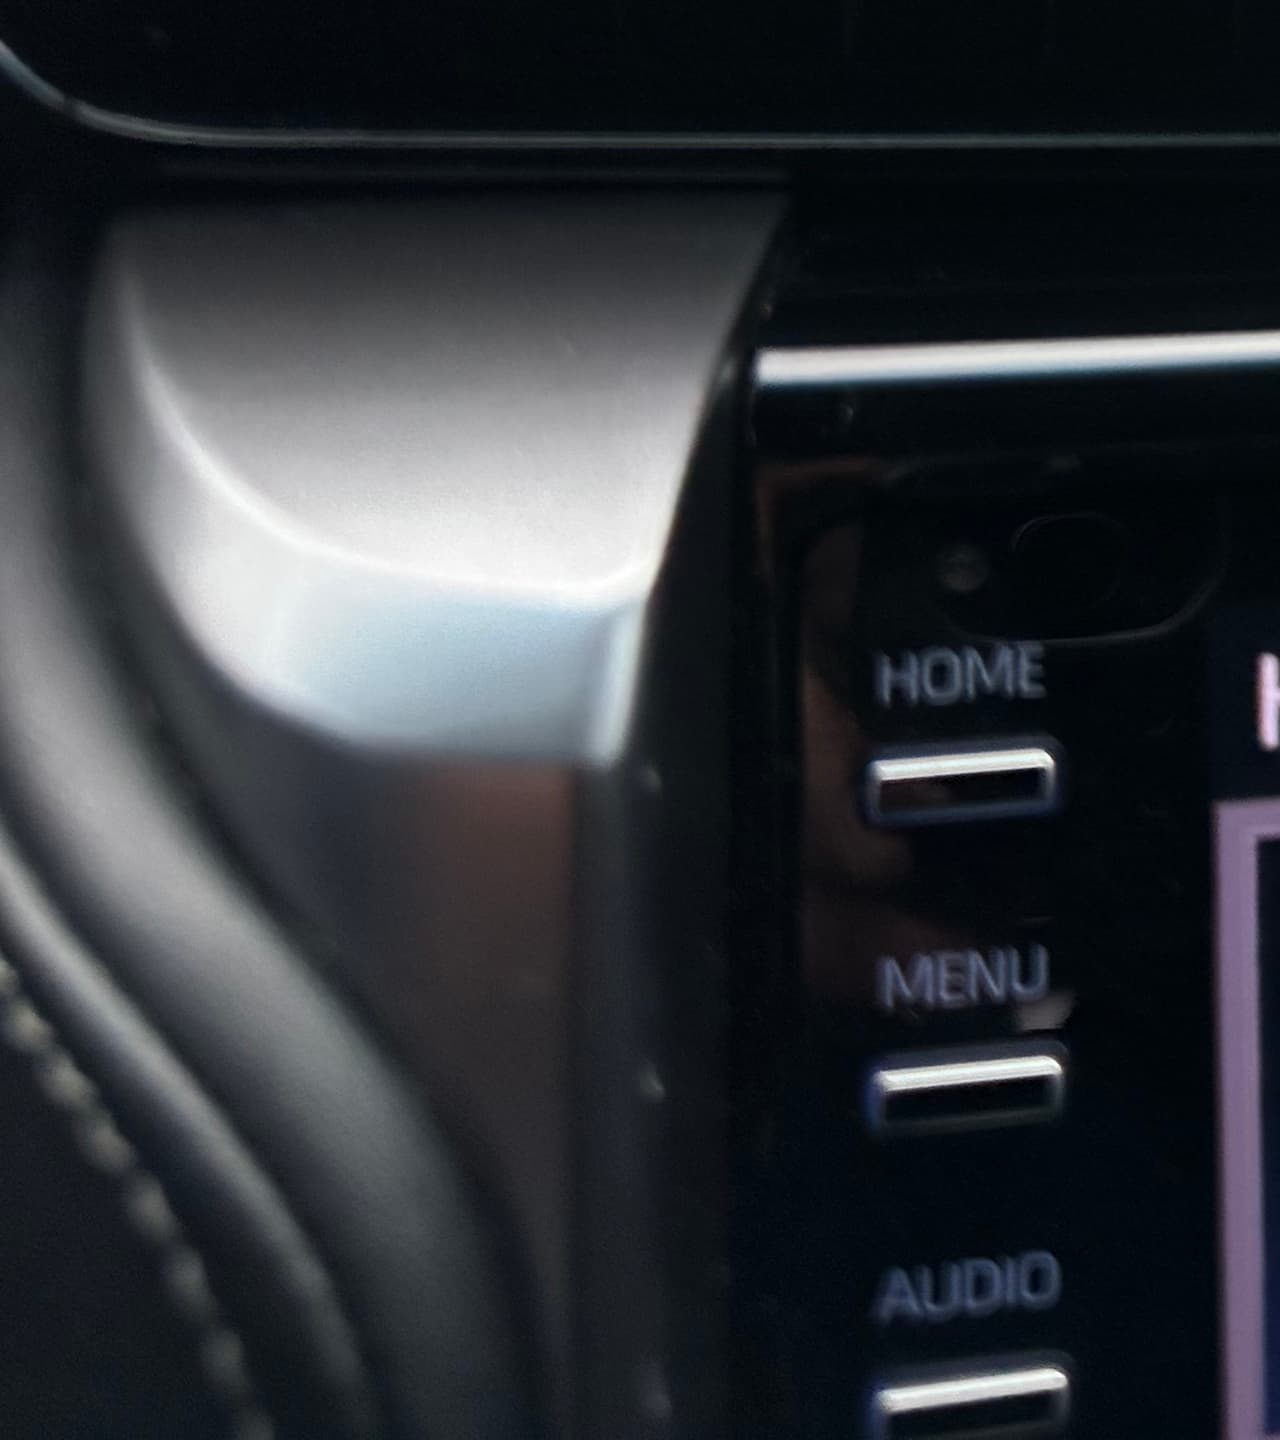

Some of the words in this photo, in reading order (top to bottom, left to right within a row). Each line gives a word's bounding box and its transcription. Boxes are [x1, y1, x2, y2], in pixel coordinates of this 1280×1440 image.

[877, 642, 1048, 706] HOME
[878, 945, 1049, 1012] MENU
[872, 1251, 1062, 1324] AUDIO
